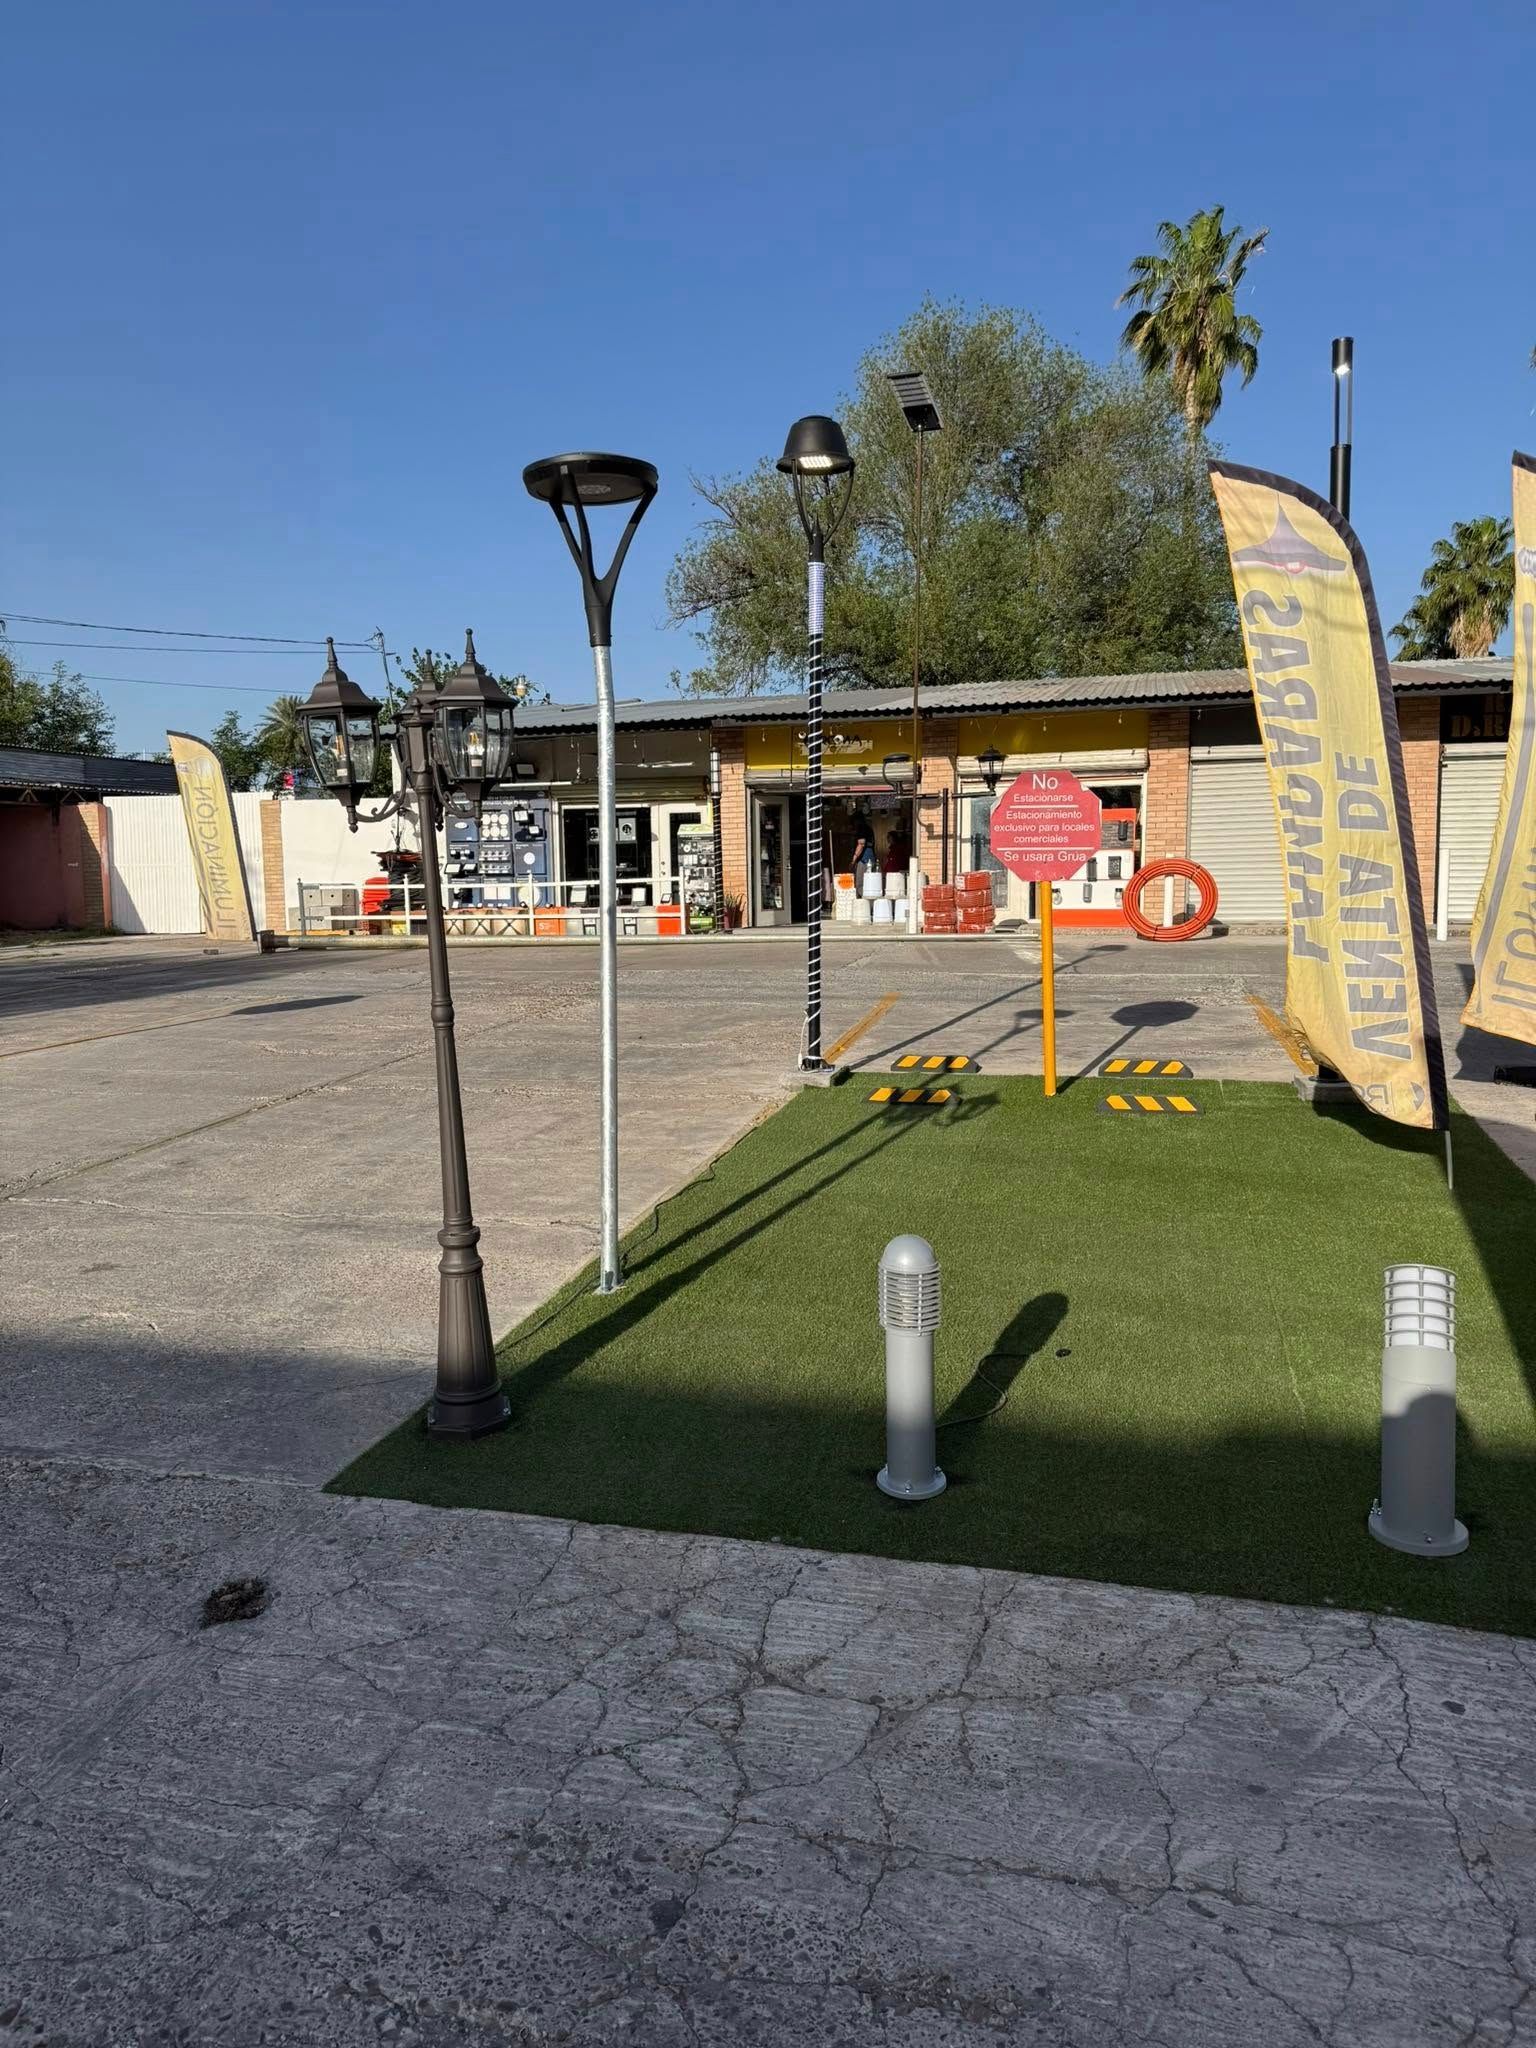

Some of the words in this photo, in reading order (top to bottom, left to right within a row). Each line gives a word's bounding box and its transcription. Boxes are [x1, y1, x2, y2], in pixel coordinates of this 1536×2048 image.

[1032, 773, 1058, 790] No
[1013, 793, 1074, 803] Estacionarse
[1006, 810, 1083, 820] Estacionamiento
[993, 823, 1036, 832] exclusivo
[1038, 824, 1060, 833] para
[1061, 823, 1096, 831] locales
[1013, 835, 1070, 843] comerciales
[1003, 852, 1020, 861] Se
[1022, 852, 1055, 862] usara
